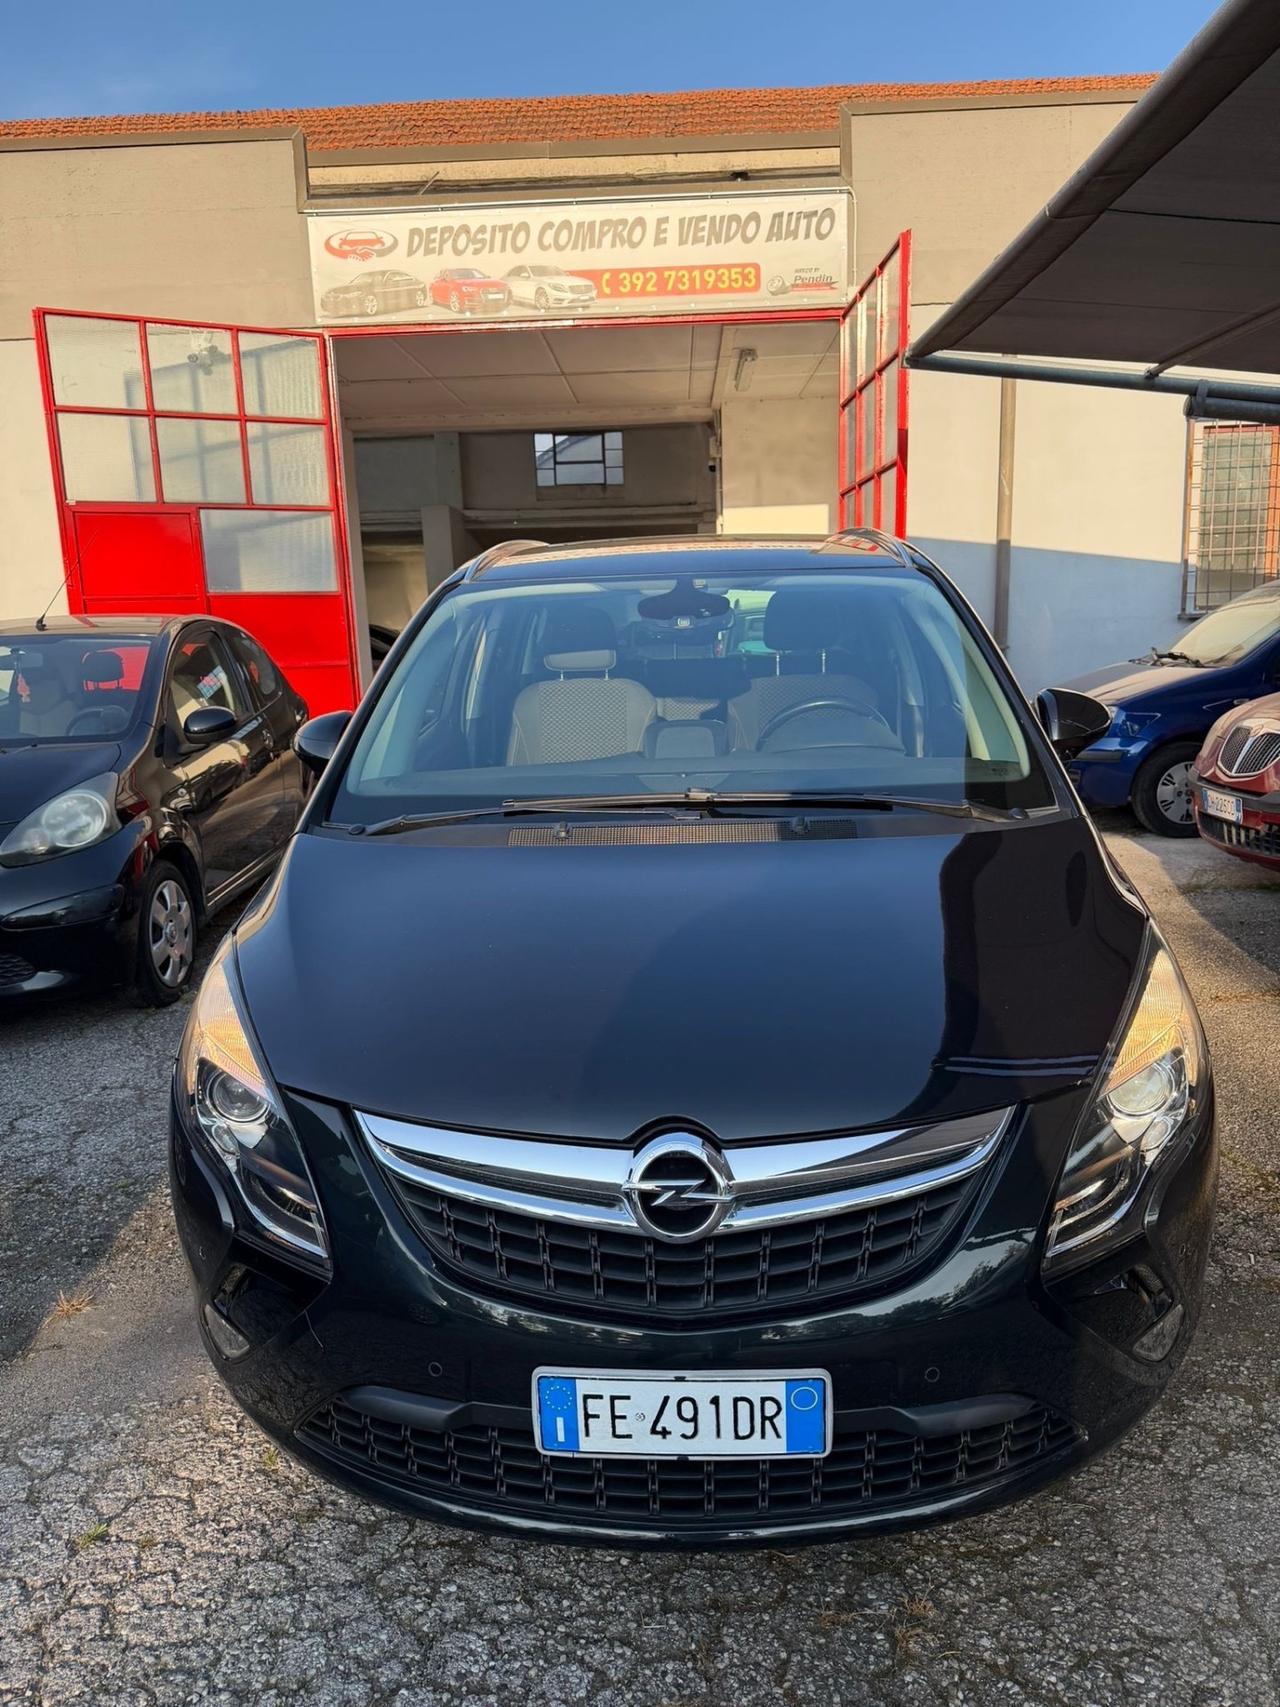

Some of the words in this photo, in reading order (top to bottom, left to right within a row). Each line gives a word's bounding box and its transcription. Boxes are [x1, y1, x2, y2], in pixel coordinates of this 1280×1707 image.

[406, 221, 531, 258] DEPOSITO
[537, 216, 647, 252] COMPRO
[653, 216, 669, 247] E
[678, 211, 762, 247] VENDO
[765, 207, 836, 243] AUTO
[619, 271, 657, 293] 392
[664, 267, 757, 291] 7319353
